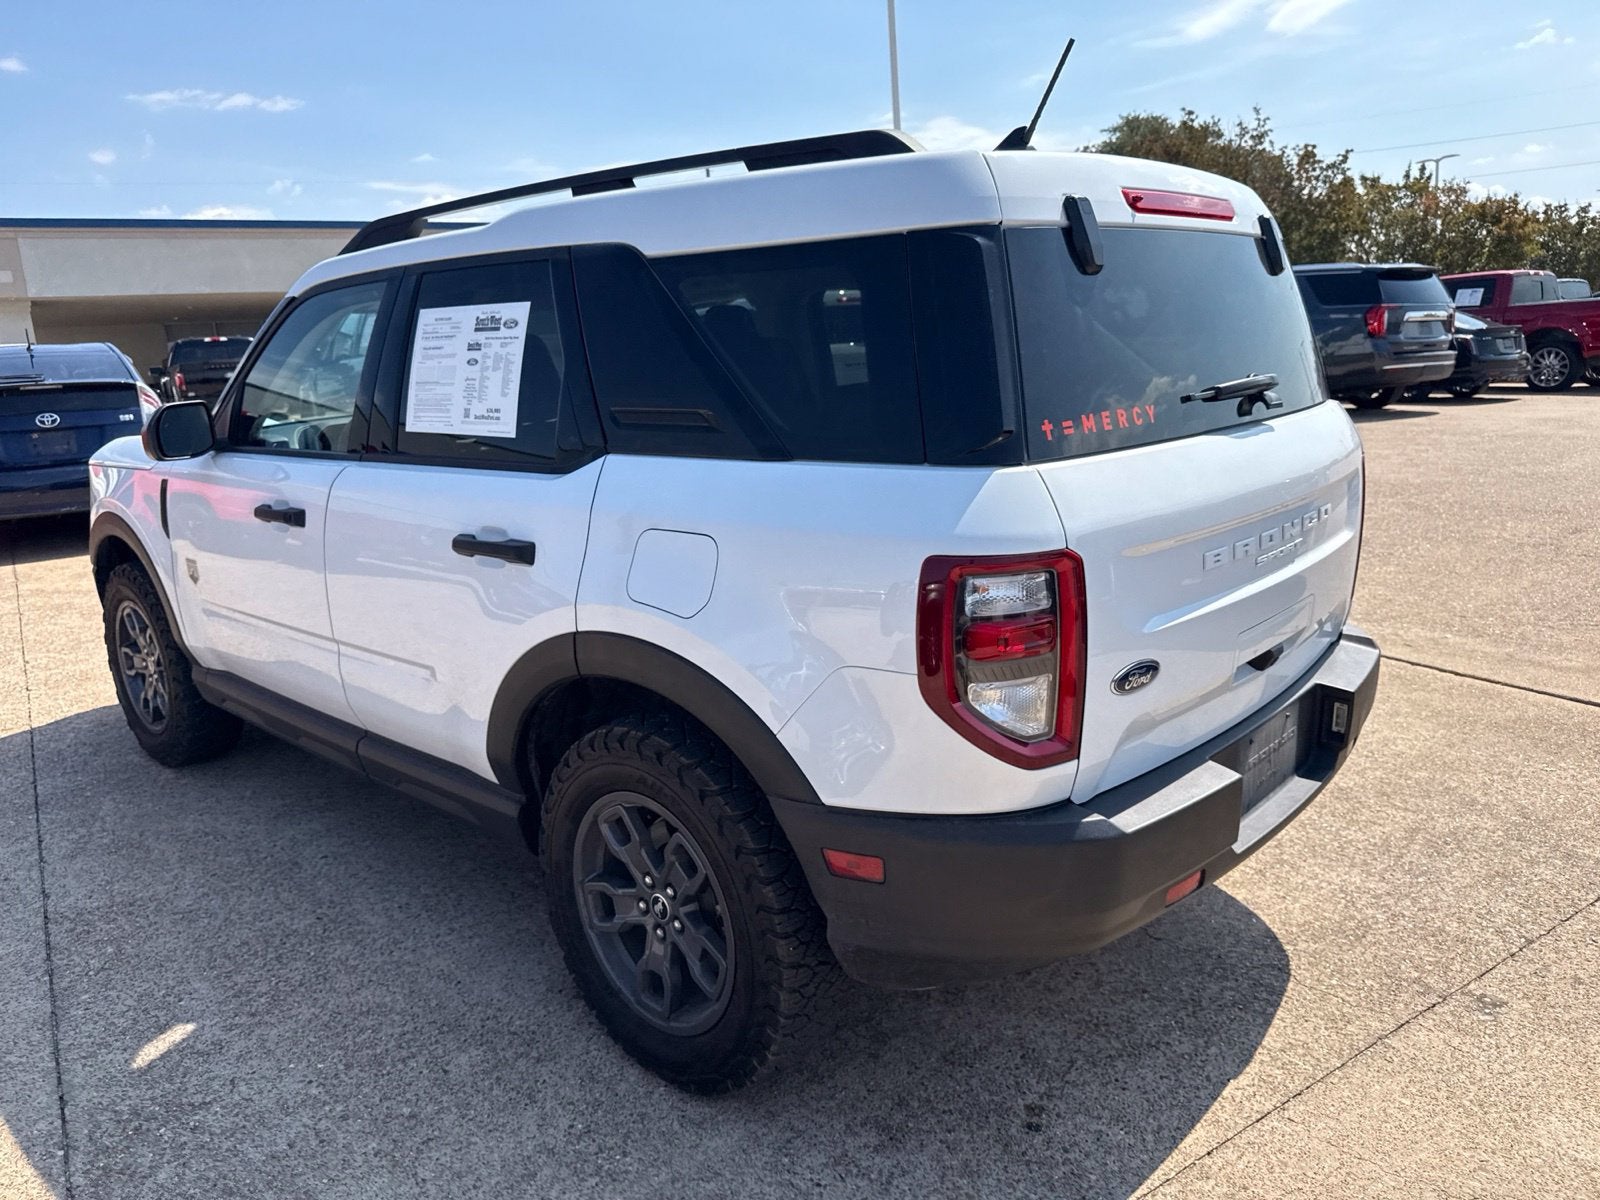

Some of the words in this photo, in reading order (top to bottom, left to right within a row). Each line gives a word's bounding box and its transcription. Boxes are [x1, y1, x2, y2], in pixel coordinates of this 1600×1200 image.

[1081, 404, 1155, 434] MERCY
[1202, 503, 1332, 573] BRONCO
[1124, 667, 1153, 690] Ford
